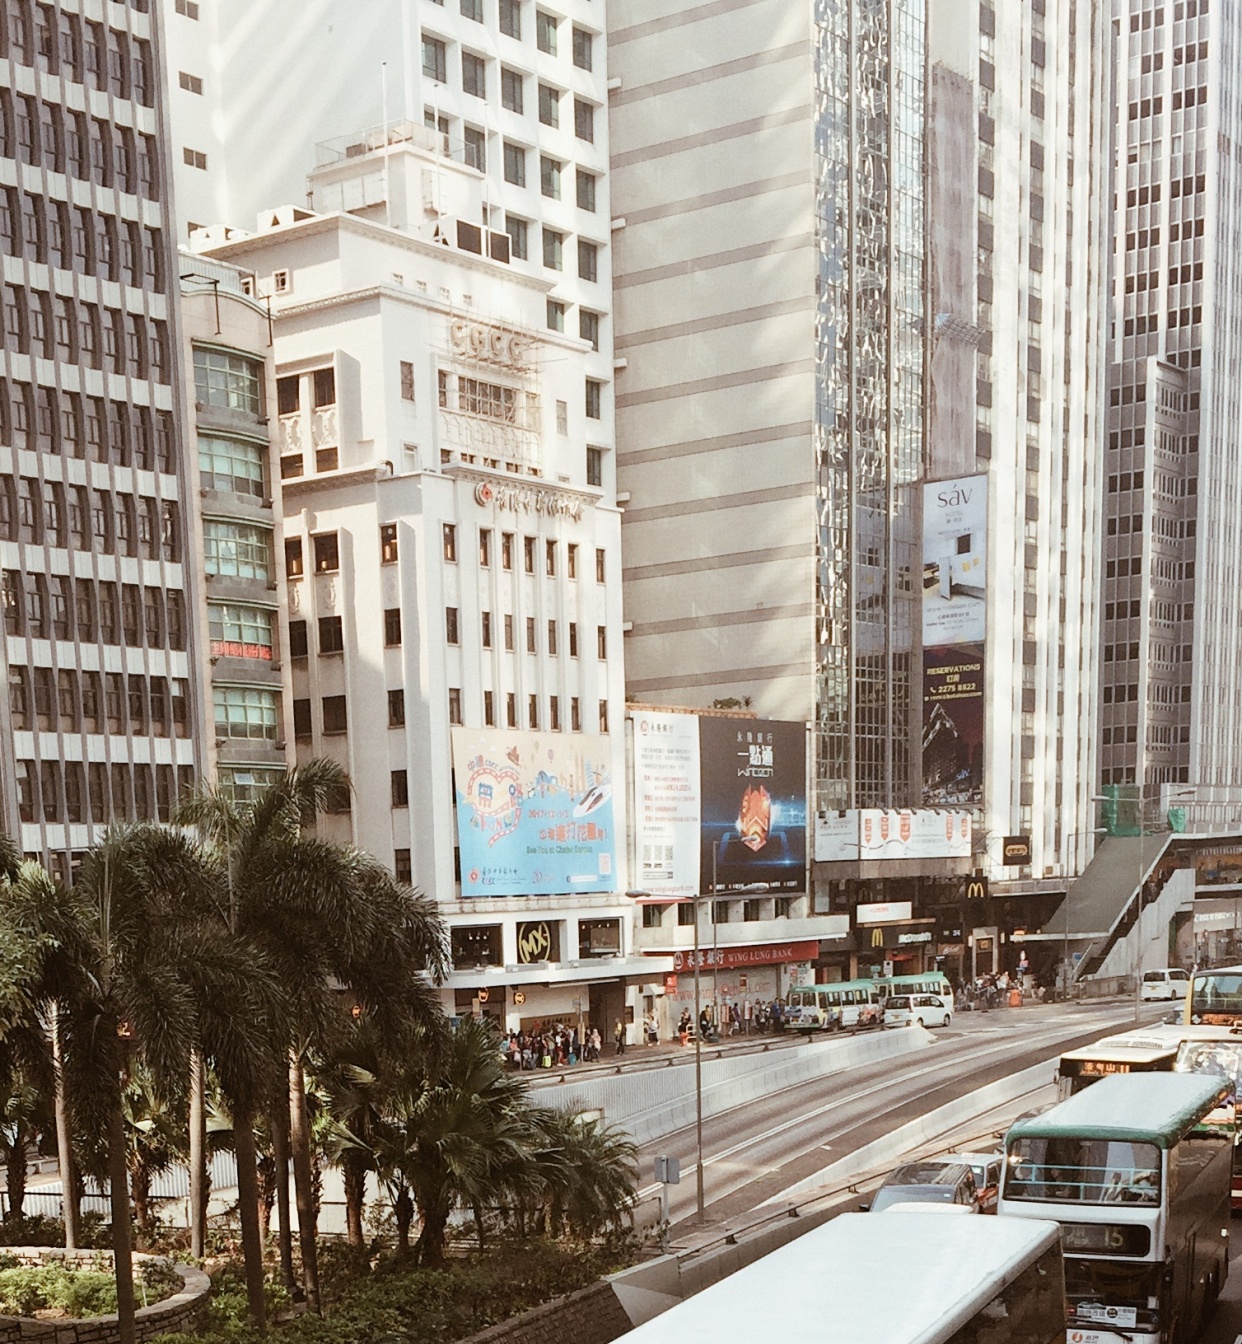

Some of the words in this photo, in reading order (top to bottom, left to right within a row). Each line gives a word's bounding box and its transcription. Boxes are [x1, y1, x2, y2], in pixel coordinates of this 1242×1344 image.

[937, 483, 973, 508] sáv
[926, 663, 980, 675] RESERVATIONS
[737, 744, 774, 766] 一點通
[728, 953, 748, 962] WING
[750, 950, 771, 961] LUNG
[772, 948, 793, 959] BANK
